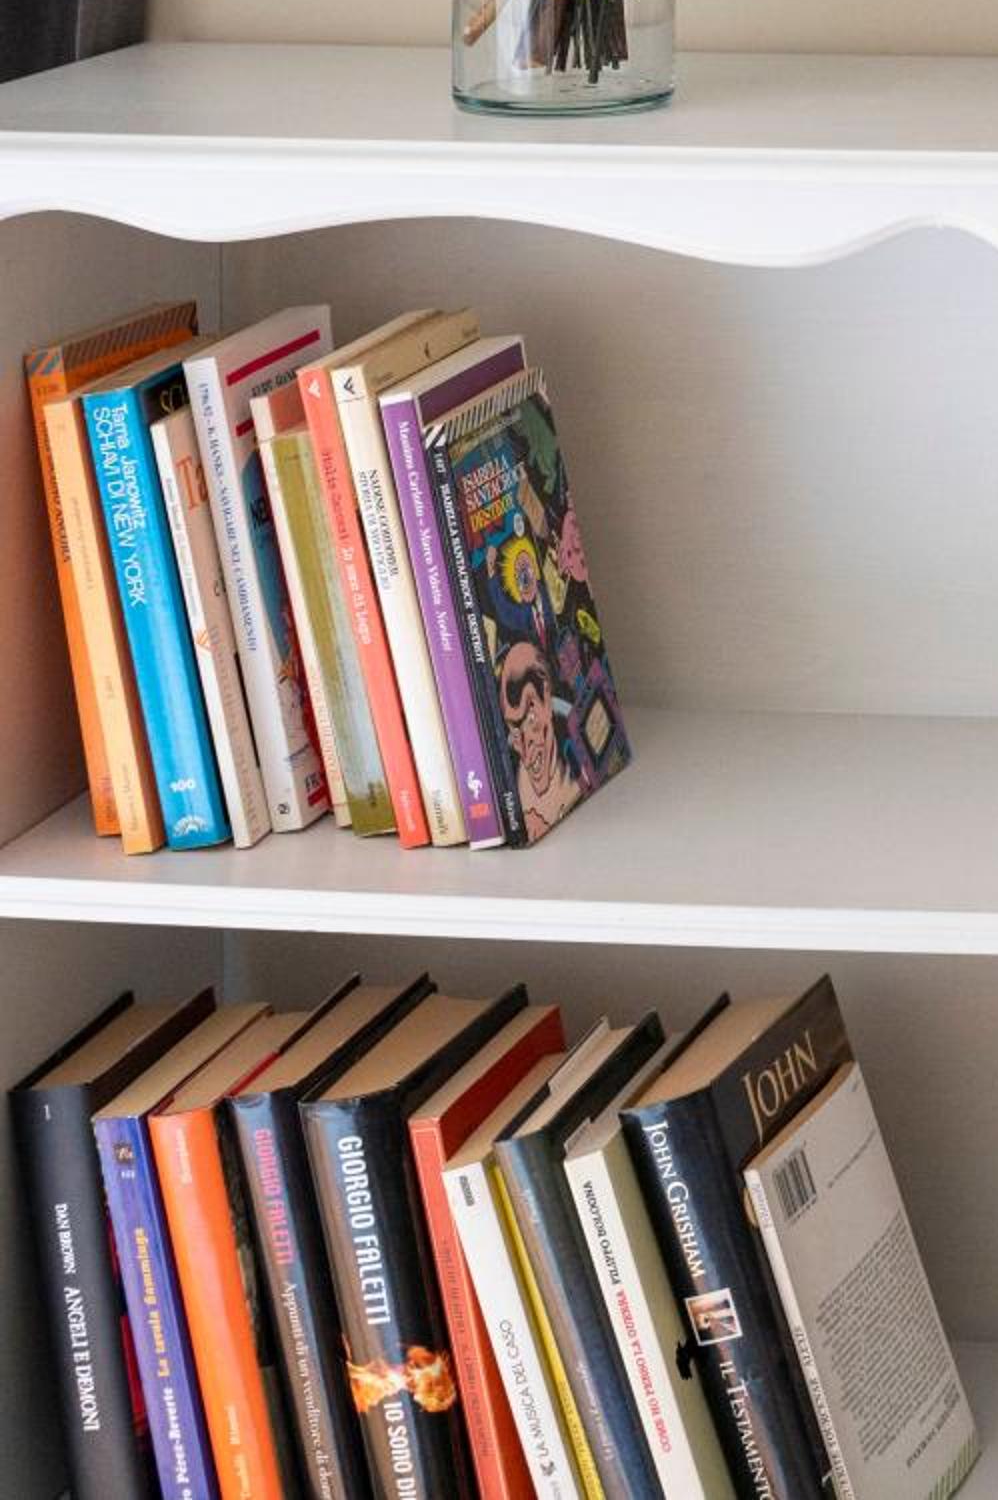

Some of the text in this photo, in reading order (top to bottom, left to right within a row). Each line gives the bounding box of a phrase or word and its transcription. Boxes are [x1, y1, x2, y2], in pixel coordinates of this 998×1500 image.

[93, 407, 147, 605] SCHIAVI DI NEW YORK
[108, 403, 145, 527] Tama Janowitz
[741, 1030, 818, 1147] JOHN
[254, 1128, 292, 1264] GIORGIO FALETTI
[337, 1134, 389, 1324] GIORGIO FALETTI
[583, 1180, 606, 1237] BOLOGNA
[643, 1121, 705, 1276] JOHN GRISHAM
[55, 1203, 99, 1430] DAN BROWN ANGELI E DEMONI
[282, 1282, 304, 1338] Appunti
[302, 1380, 323, 1446] venditore
[498, 1319, 549, 1458] LA MUSICA DEL CASO
[616, 1290, 671, 1452] COME HO PERSO LA GUERRA
[383, 1401, 404, 1422] IO
